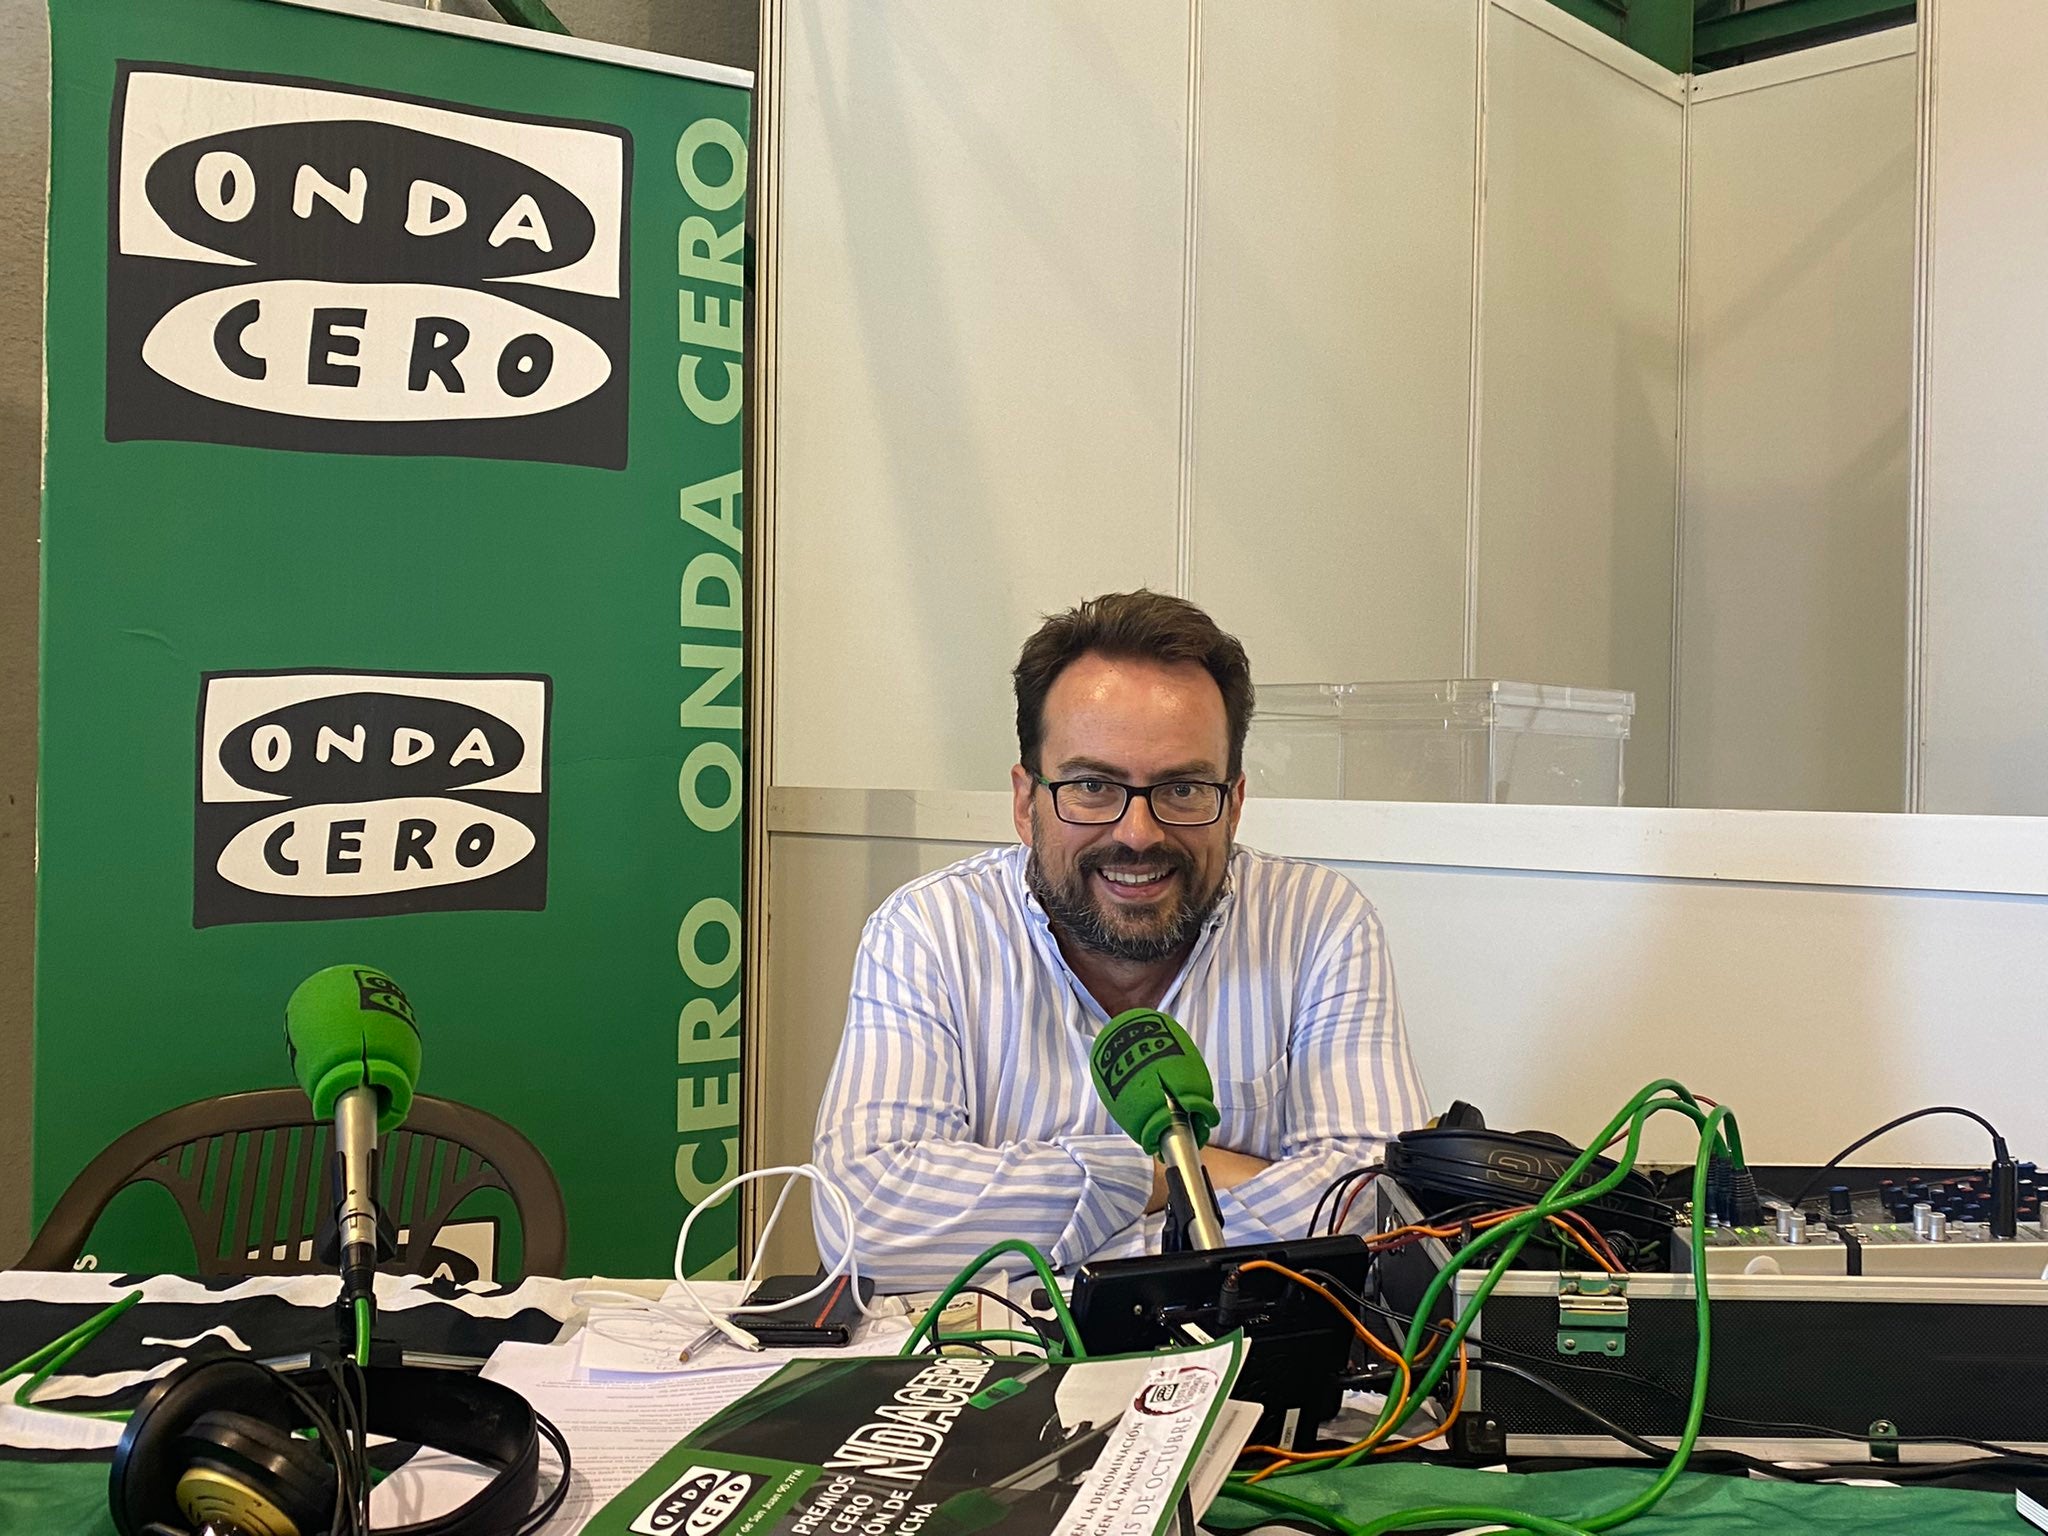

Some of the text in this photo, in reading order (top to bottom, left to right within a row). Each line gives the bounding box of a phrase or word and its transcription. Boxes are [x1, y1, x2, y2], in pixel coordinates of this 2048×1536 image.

[195, 150, 553, 253] ONDA
[676, 118, 748, 425] CERO
[214, 298, 554, 398] CERO
[679, 469, 743, 832] ONDA
[250, 723, 494, 771] ONDA
[263, 818, 495, 876] CERO
[675, 897, 741, 1208] CERO
[1104, 1024, 1155, 1062] ONDA
[1114, 1039, 1165, 1077] CERO
[1080, 1507, 1097, 1520] LA
[1090, 1422, 1144, 1504] DENOMINACIÓN
[1107, 1498, 1124, 1511] LA
[1117, 1449, 1149, 1495] MANCHA
[1131, 1495, 1156, 1515] DE
[1145, 1416, 1193, 1489] OCTUBRE
[654, 1478, 713, 1526] ONDA
[691, 1483, 744, 1528] CERO
[748, 1510, 767, 1523] San
[762, 1493, 782, 1510] Juan
[791, 1475, 856, 1536] PREMIOS
[830, 1494, 874, 1534] CERO
[858, 1490, 913, 1536] ÓN DE
